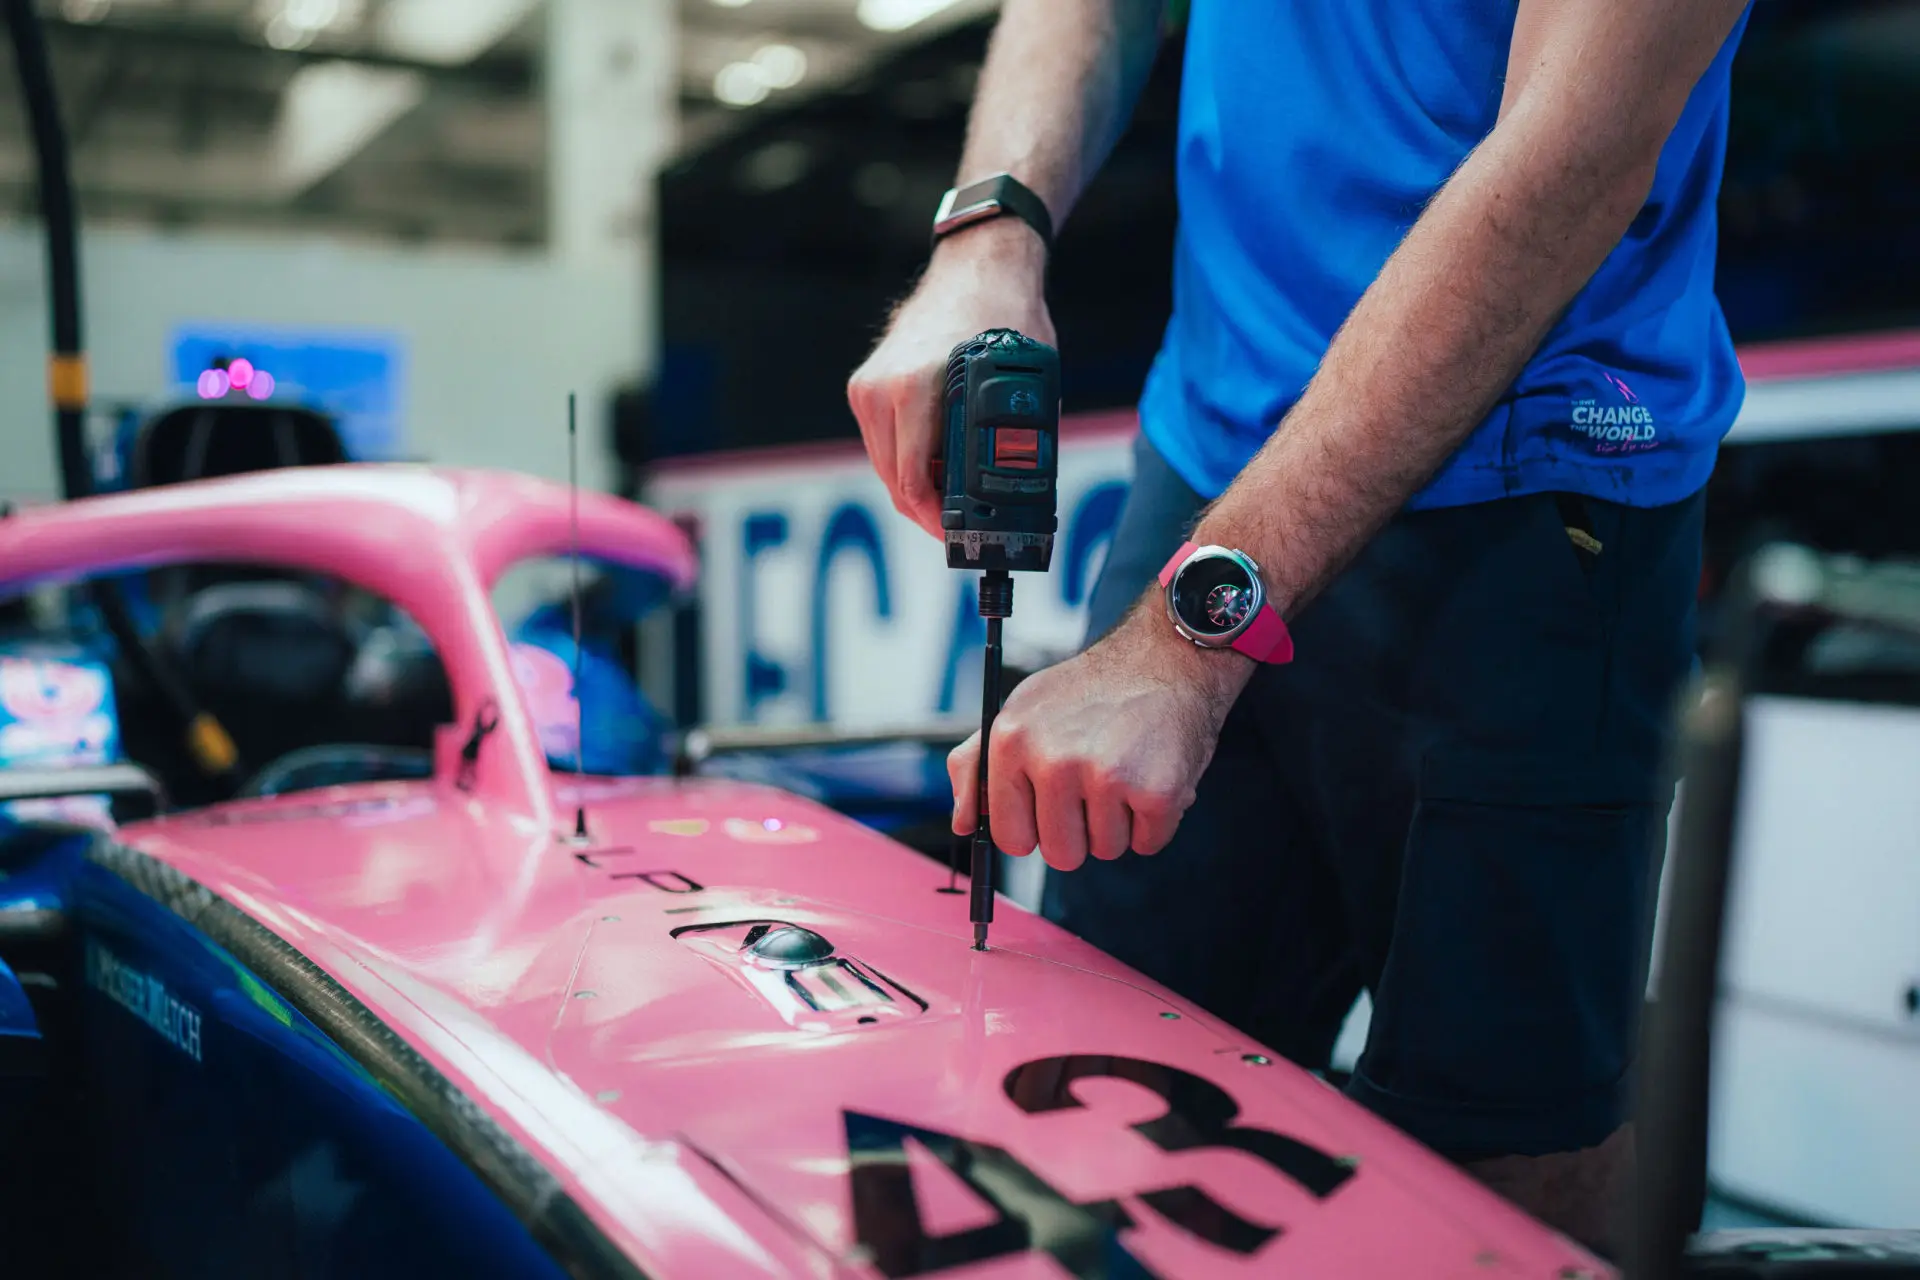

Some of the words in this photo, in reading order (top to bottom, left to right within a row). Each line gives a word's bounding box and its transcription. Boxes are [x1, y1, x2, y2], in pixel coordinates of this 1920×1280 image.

[1572, 406, 1653, 425] CHANGE
[1569, 424, 1588, 432] THE
[1588, 424, 1656, 441] WORLD
